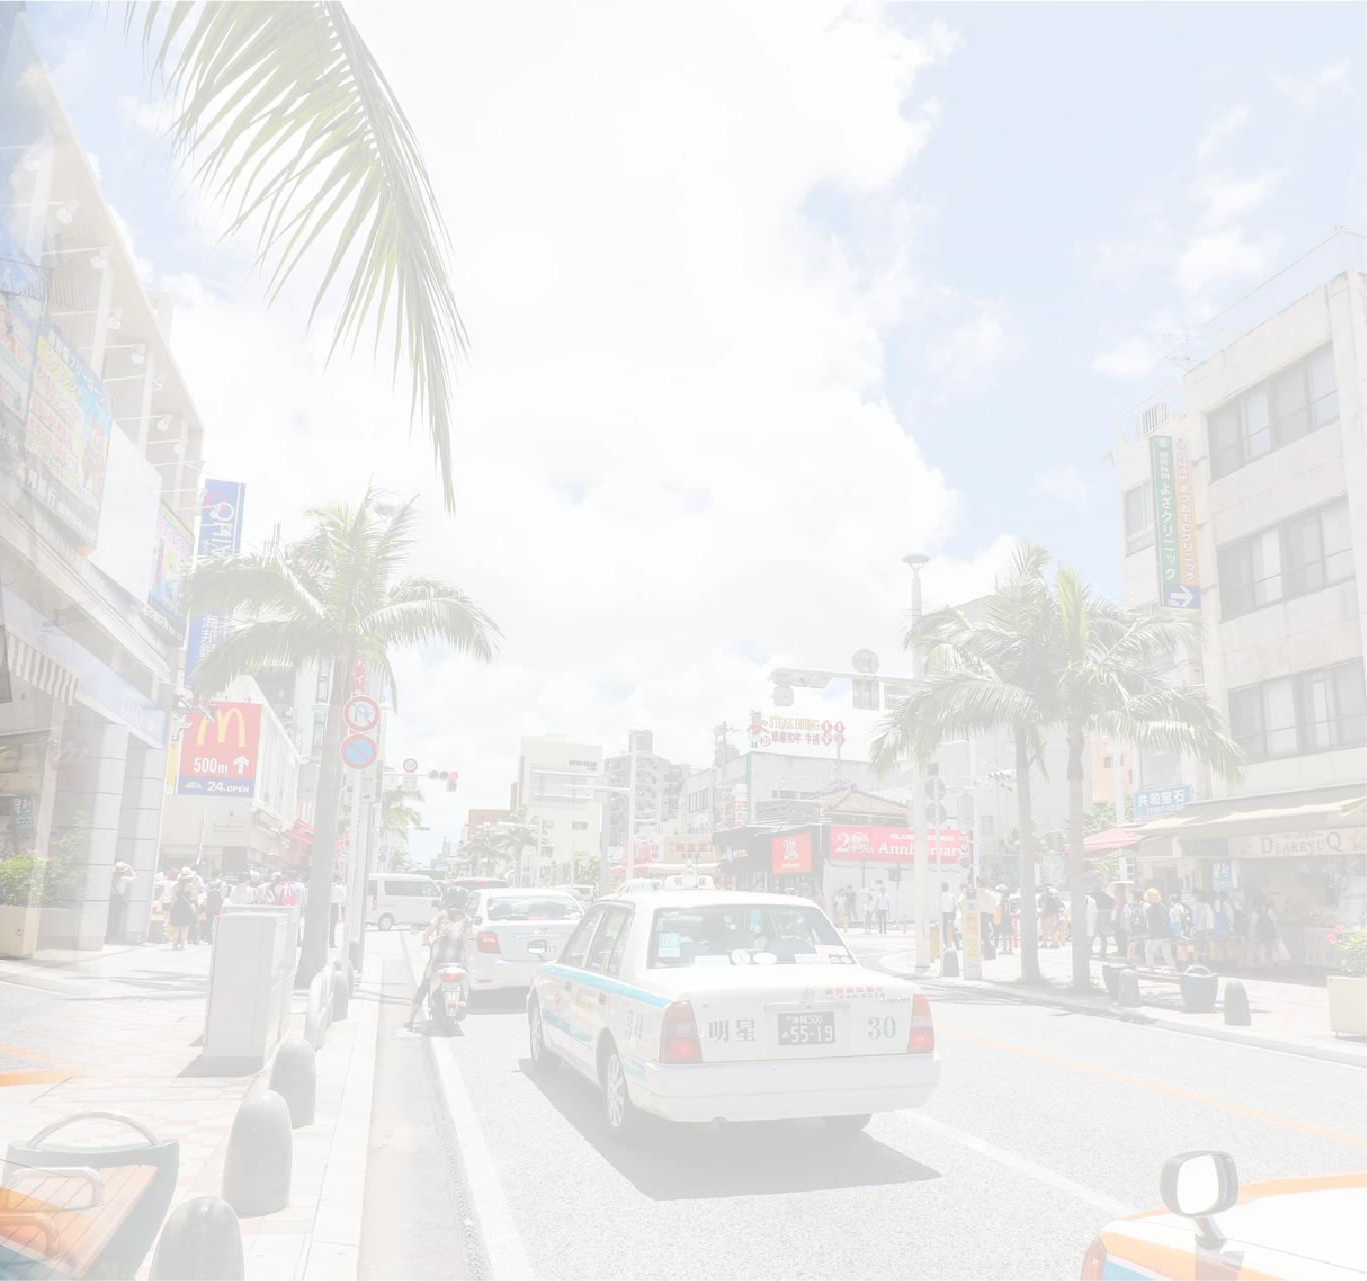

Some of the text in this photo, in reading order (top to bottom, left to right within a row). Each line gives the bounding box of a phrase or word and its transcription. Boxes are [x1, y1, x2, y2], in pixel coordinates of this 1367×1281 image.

[769, 716, 821, 731] STEAK DINING
[194, 757, 228, 774] 500m
[226, 785, 250, 793] OPEN
[1138, 790, 1184, 807] 共和宝石
[676, 843, 708, 853] 東宝堂
[625, 1010, 643, 1044] 30
[709, 1018, 755, 1043] 明星
[791, 1025, 833, 1043] 55-19
[868, 1016, 896, 1040] 30
